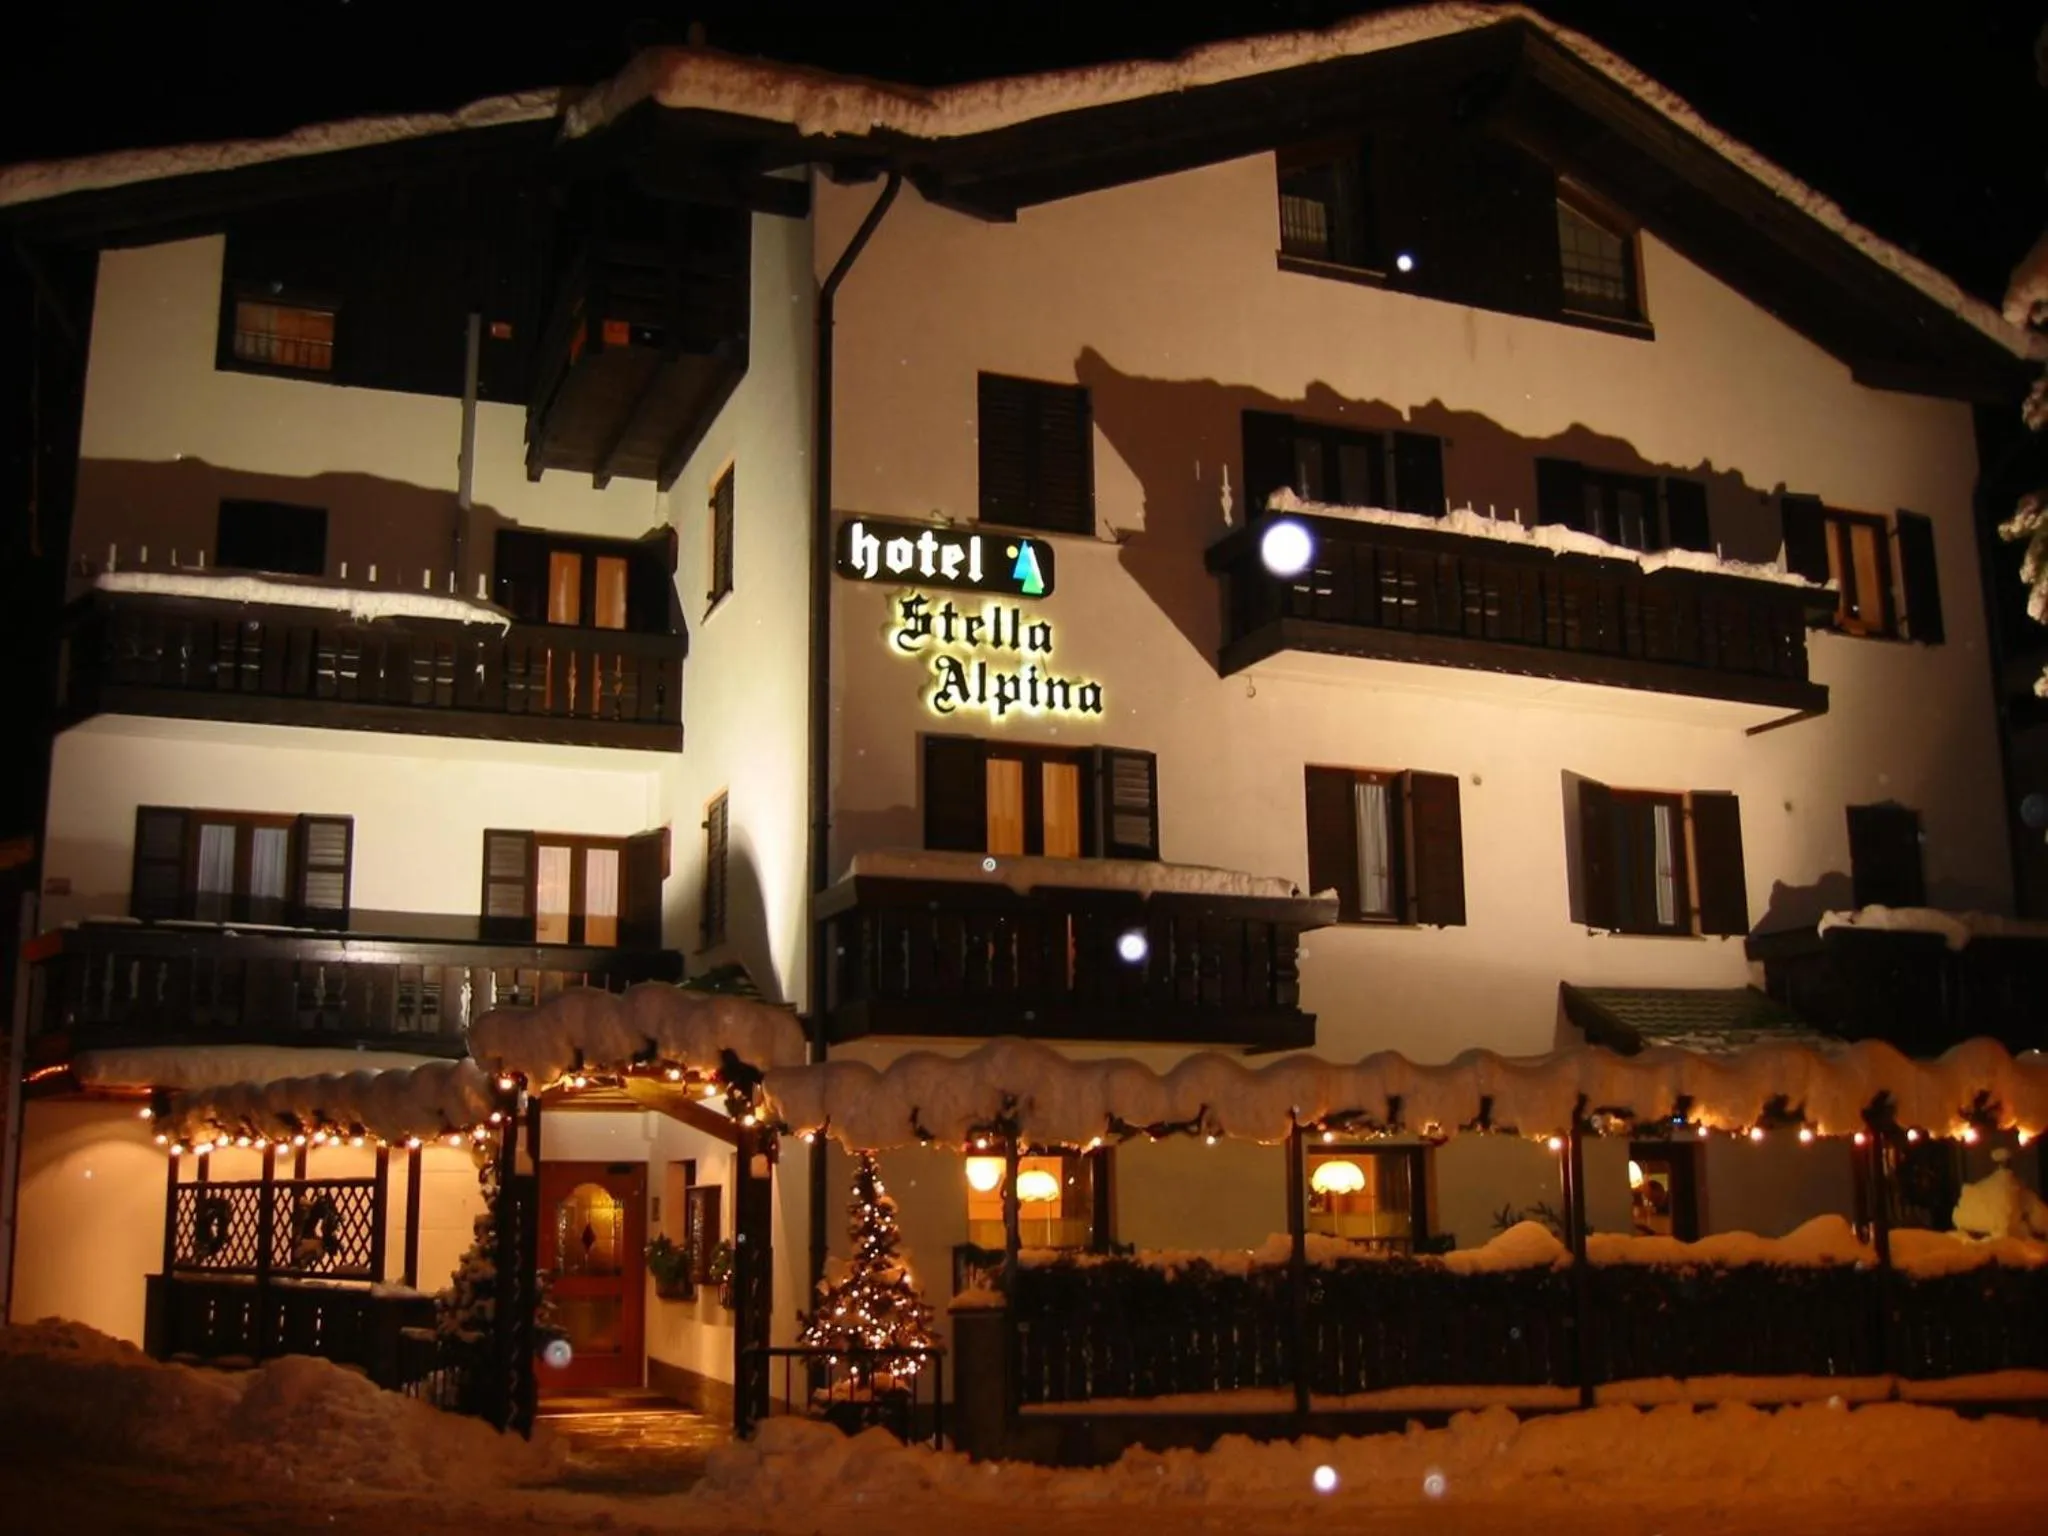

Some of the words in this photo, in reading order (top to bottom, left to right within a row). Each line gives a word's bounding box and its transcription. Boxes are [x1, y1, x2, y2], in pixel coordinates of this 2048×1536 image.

[850, 521, 984, 583] hotel
[896, 593, 1053, 654] Stella
[933, 654, 1104, 715] Alpina
